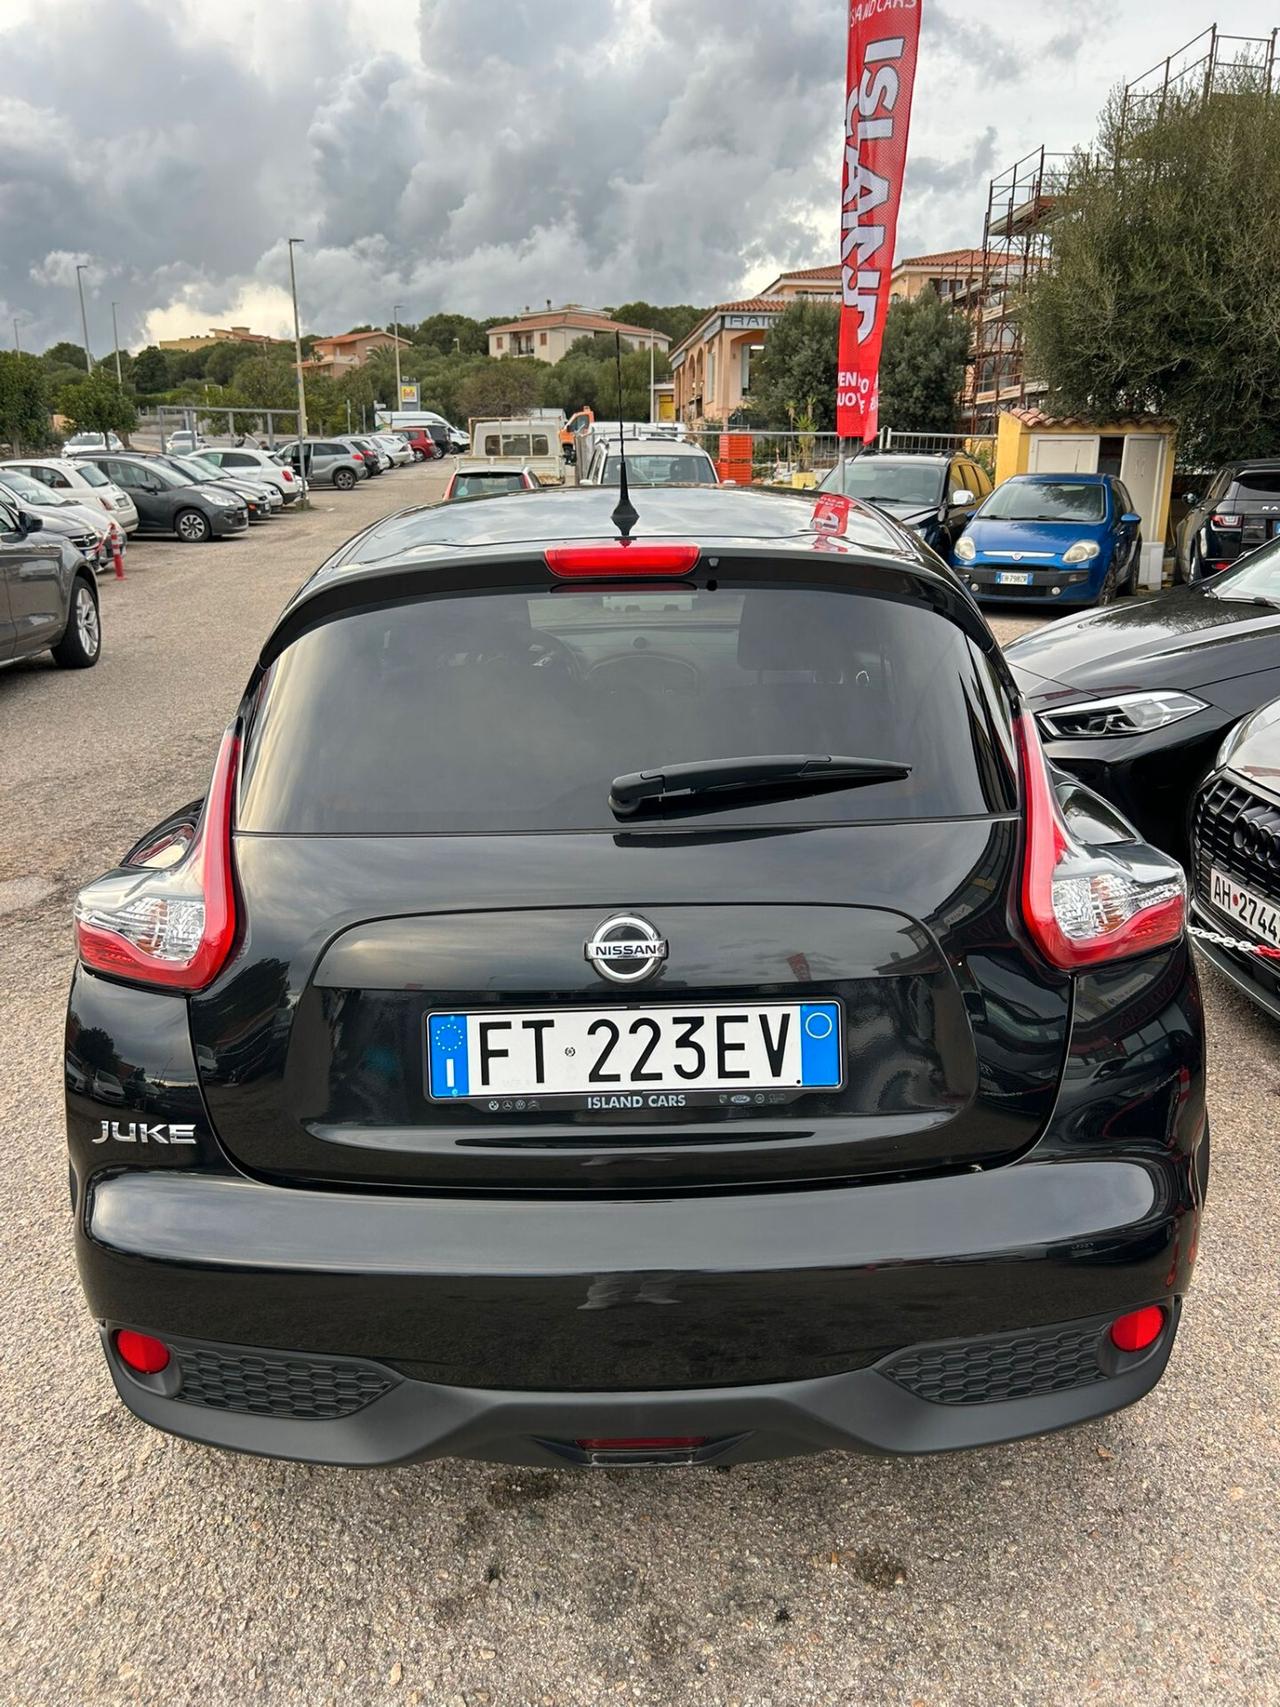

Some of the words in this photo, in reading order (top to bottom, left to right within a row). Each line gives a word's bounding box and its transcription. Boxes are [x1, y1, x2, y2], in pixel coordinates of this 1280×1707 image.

[1214, 875, 1231, 910] AH
[1239, 892, 1280, 944] 2744
[595, 944, 657, 956] NISSAN
[479, 1019, 555, 1086] FT
[587, 1013, 791, 1083] 223EV
[587, 1096, 644, 1109] ISLAND
[648, 1094, 687, 1107] CARS
[91, 1120, 197, 1144] JUKE
